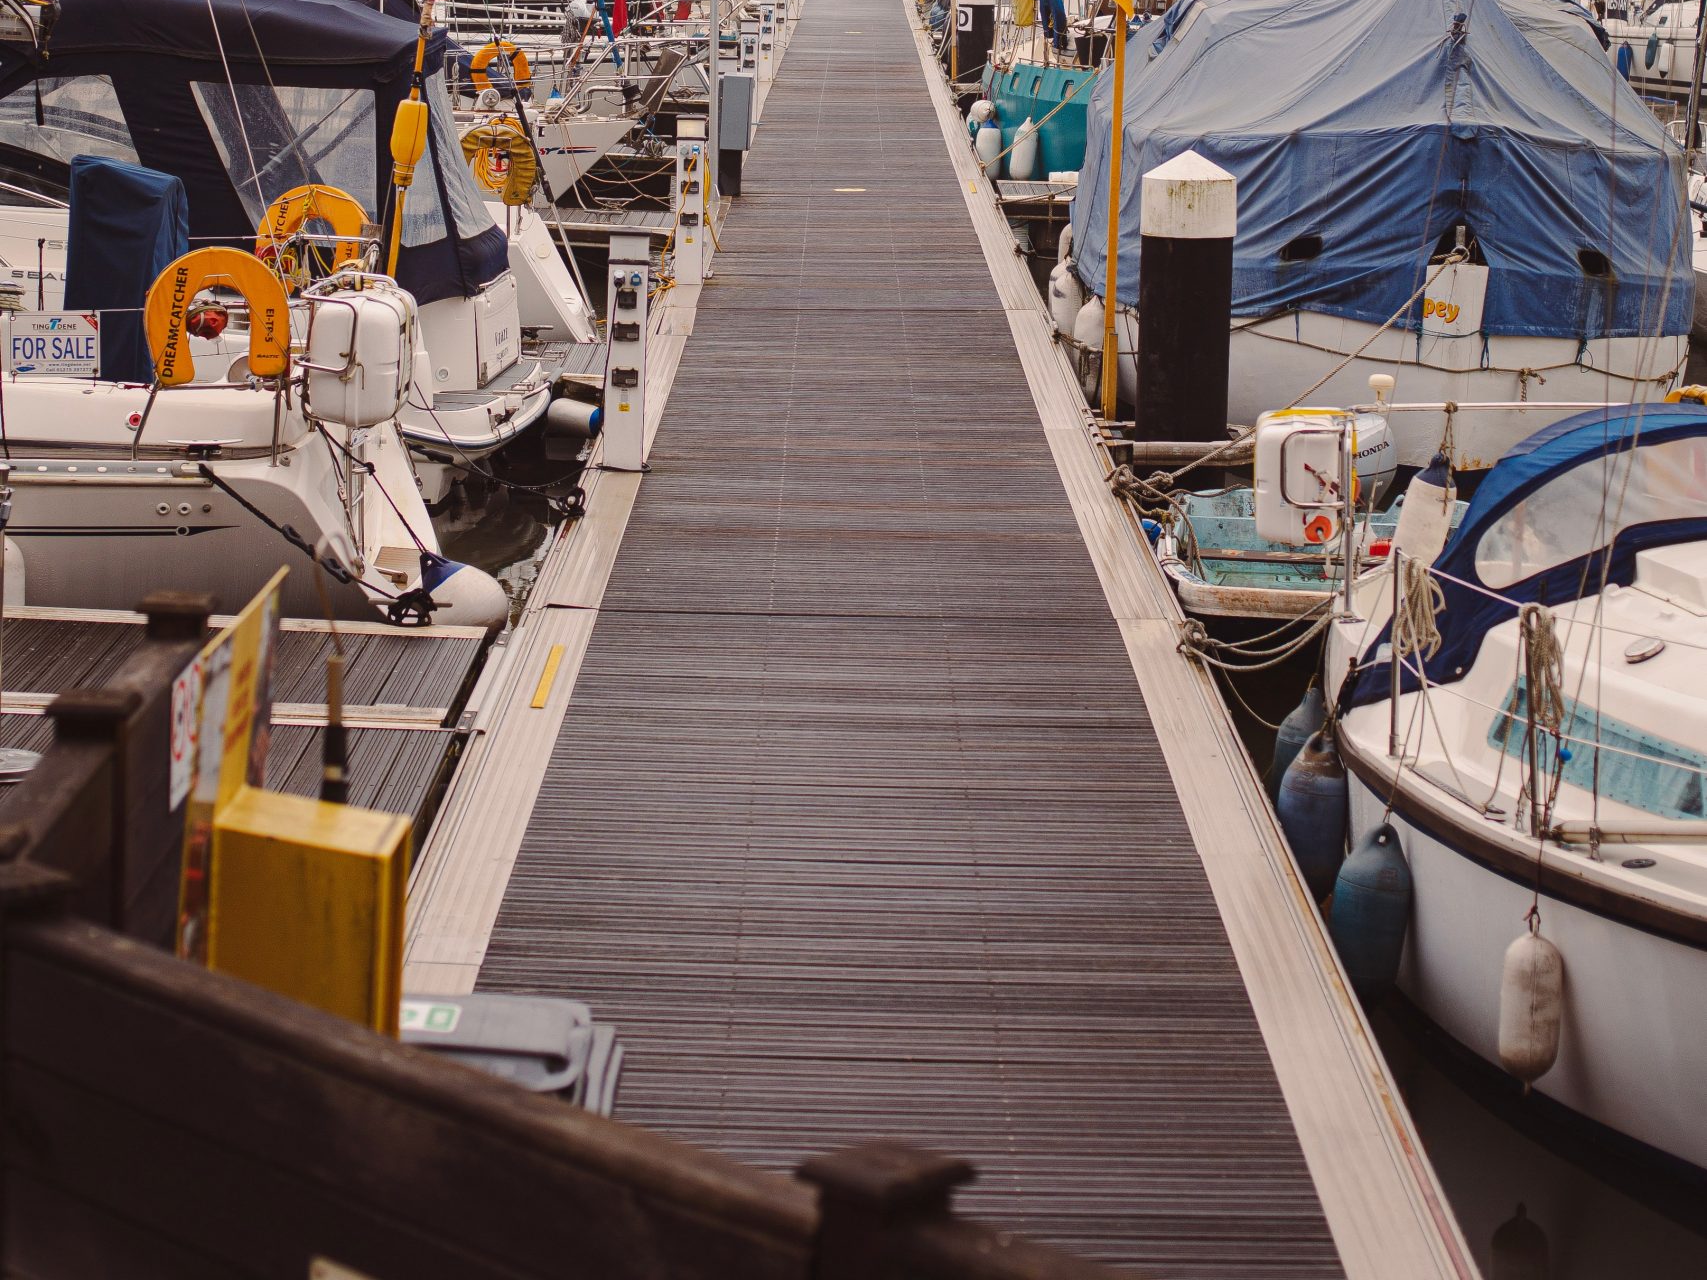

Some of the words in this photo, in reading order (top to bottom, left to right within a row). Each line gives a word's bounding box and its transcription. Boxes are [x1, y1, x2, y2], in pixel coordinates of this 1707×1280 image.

[958, 9, 969, 27] D
[162, 267, 188, 378] DREAMCATCHER
[13, 337, 46, 360] FOR
[52, 336, 95, 360] SALE
